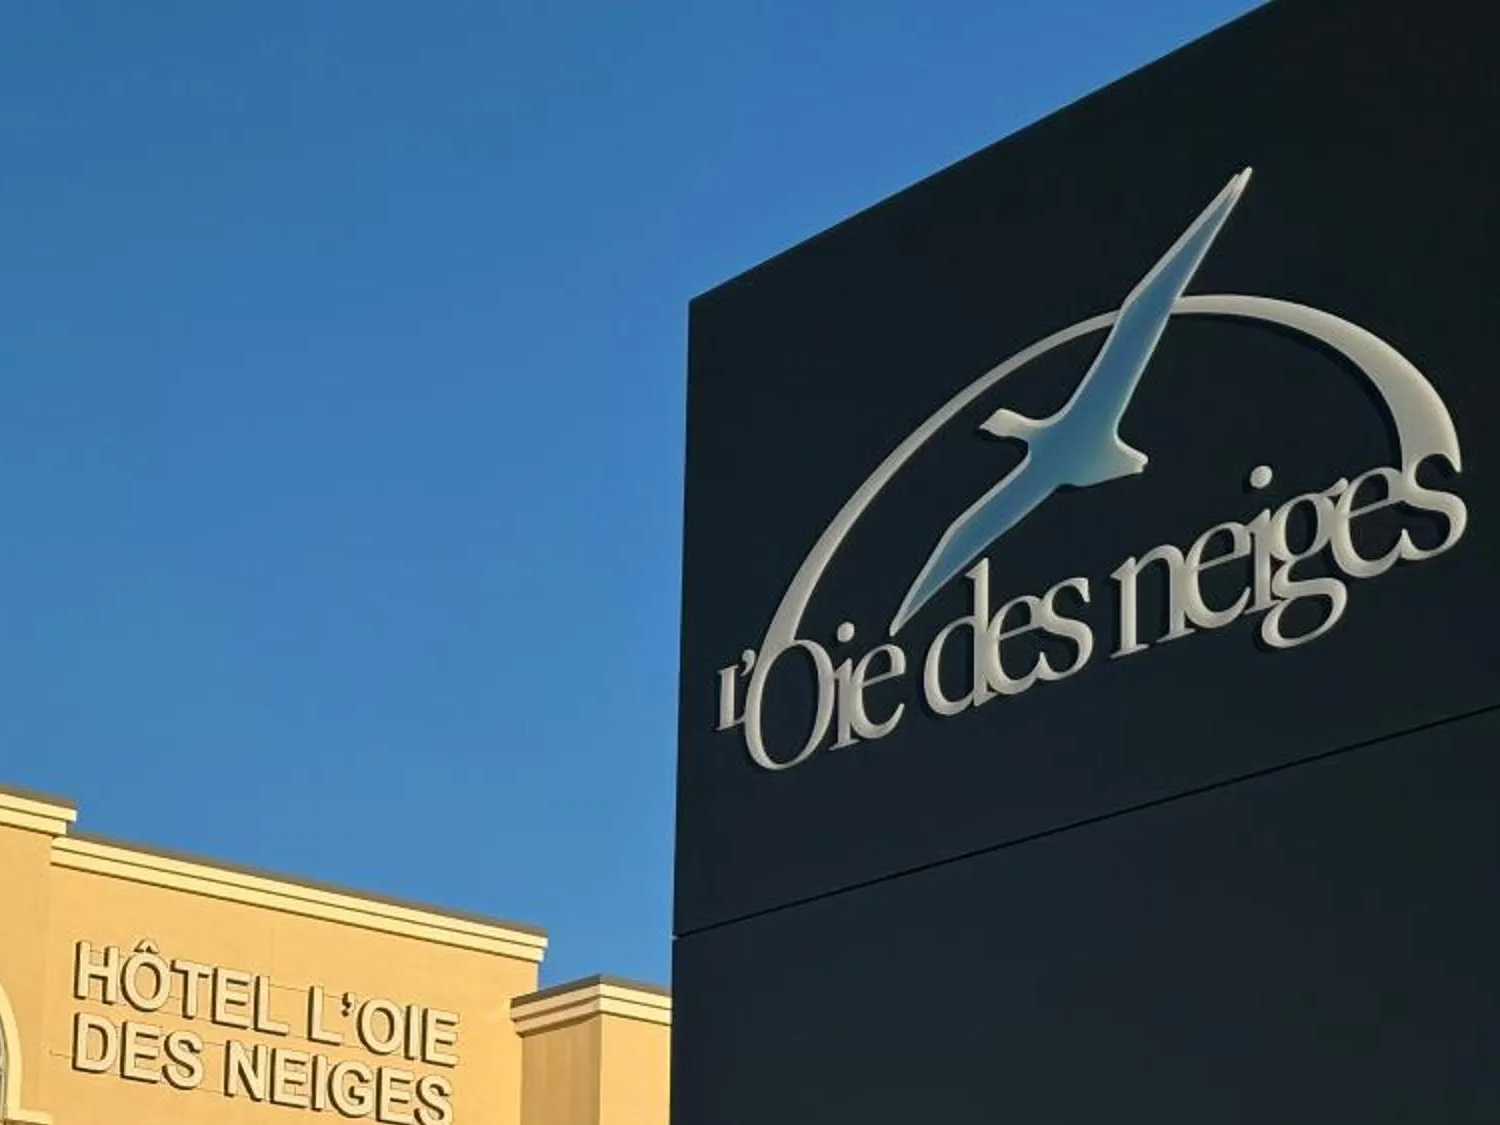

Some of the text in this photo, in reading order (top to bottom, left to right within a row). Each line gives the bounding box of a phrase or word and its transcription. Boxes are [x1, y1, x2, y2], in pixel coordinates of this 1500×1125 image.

[716, 453, 1467, 770] L'Oie des neiges
[72, 1012, 204, 1090] DES
[74, 939, 460, 1067] HÔTEL L'OIE
